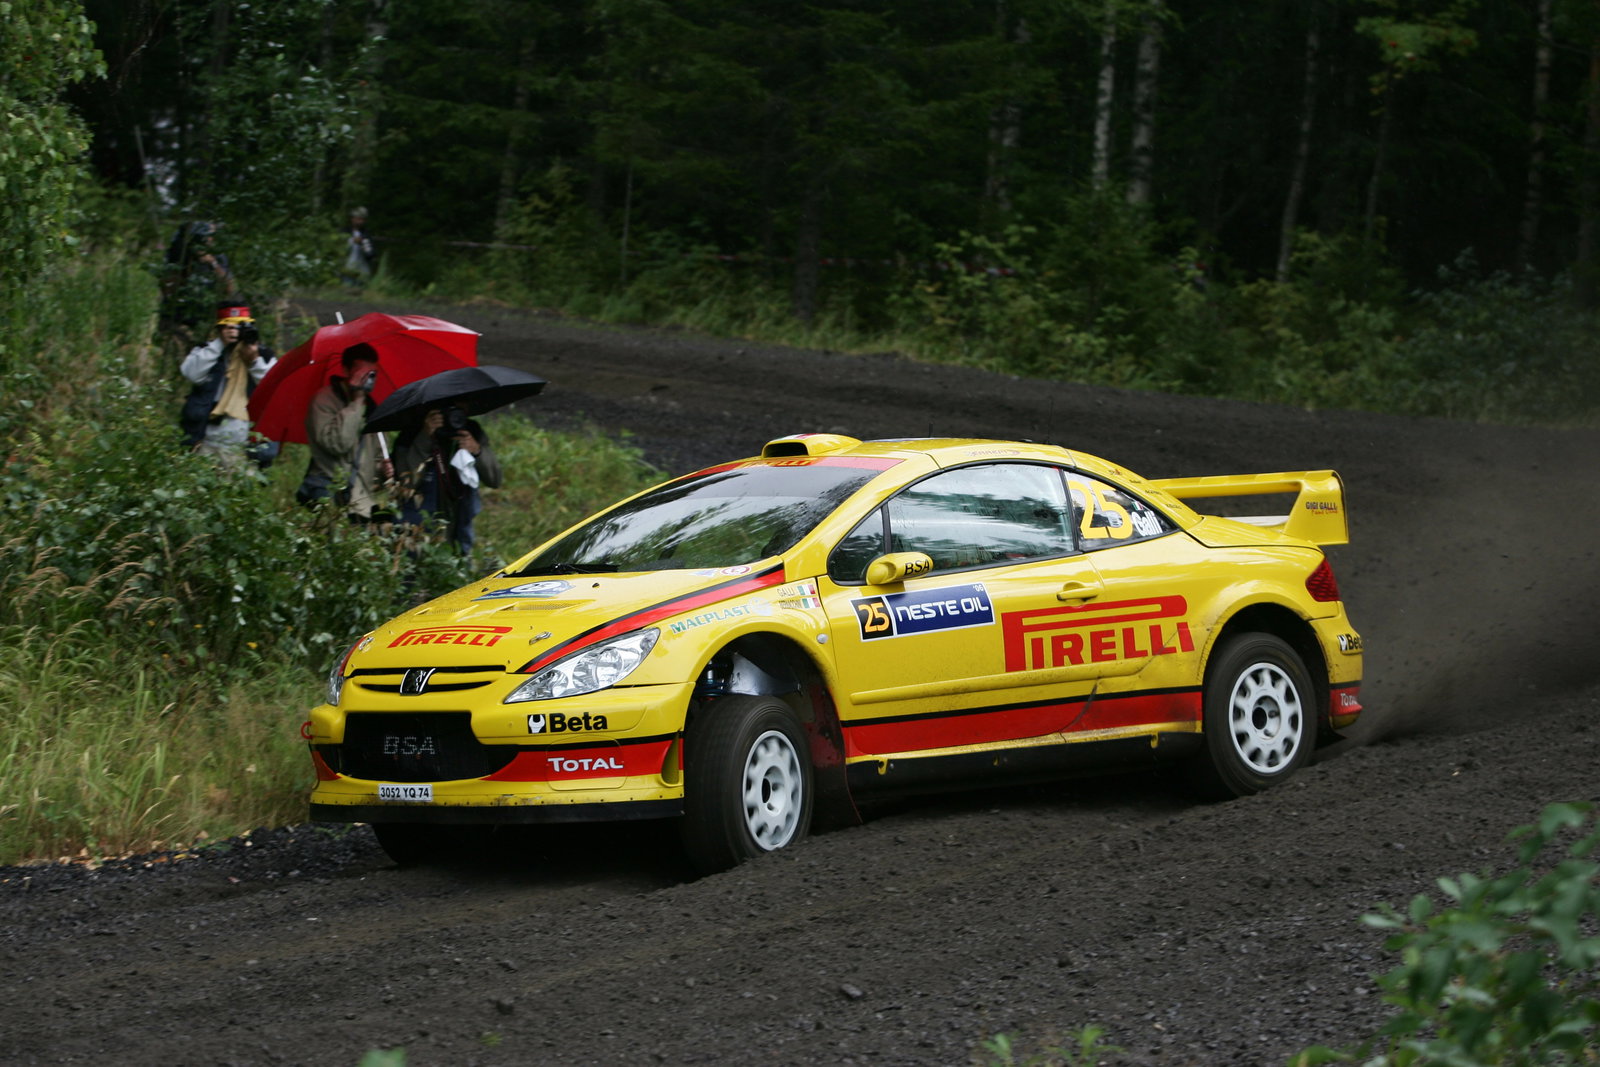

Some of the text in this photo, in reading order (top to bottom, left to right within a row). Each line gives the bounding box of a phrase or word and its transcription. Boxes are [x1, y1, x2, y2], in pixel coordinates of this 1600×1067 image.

[1068, 480, 1134, 540] 25
[1131, 510, 1164, 537] Galli
[904, 559, 931, 576] BSA
[670, 605, 751, 634] MACPLAST
[858, 602, 891, 633] 25
[895, 597, 989, 622] NESTE OIL
[386, 625, 513, 648] PIRELLI
[1001, 595, 1195, 672] PIRELLI
[549, 711, 609, 733] Beta
[384, 735, 436, 755] BSA
[547, 757, 624, 773] TOTAL
[380, 787, 430, 799] 3052 YQ 74
